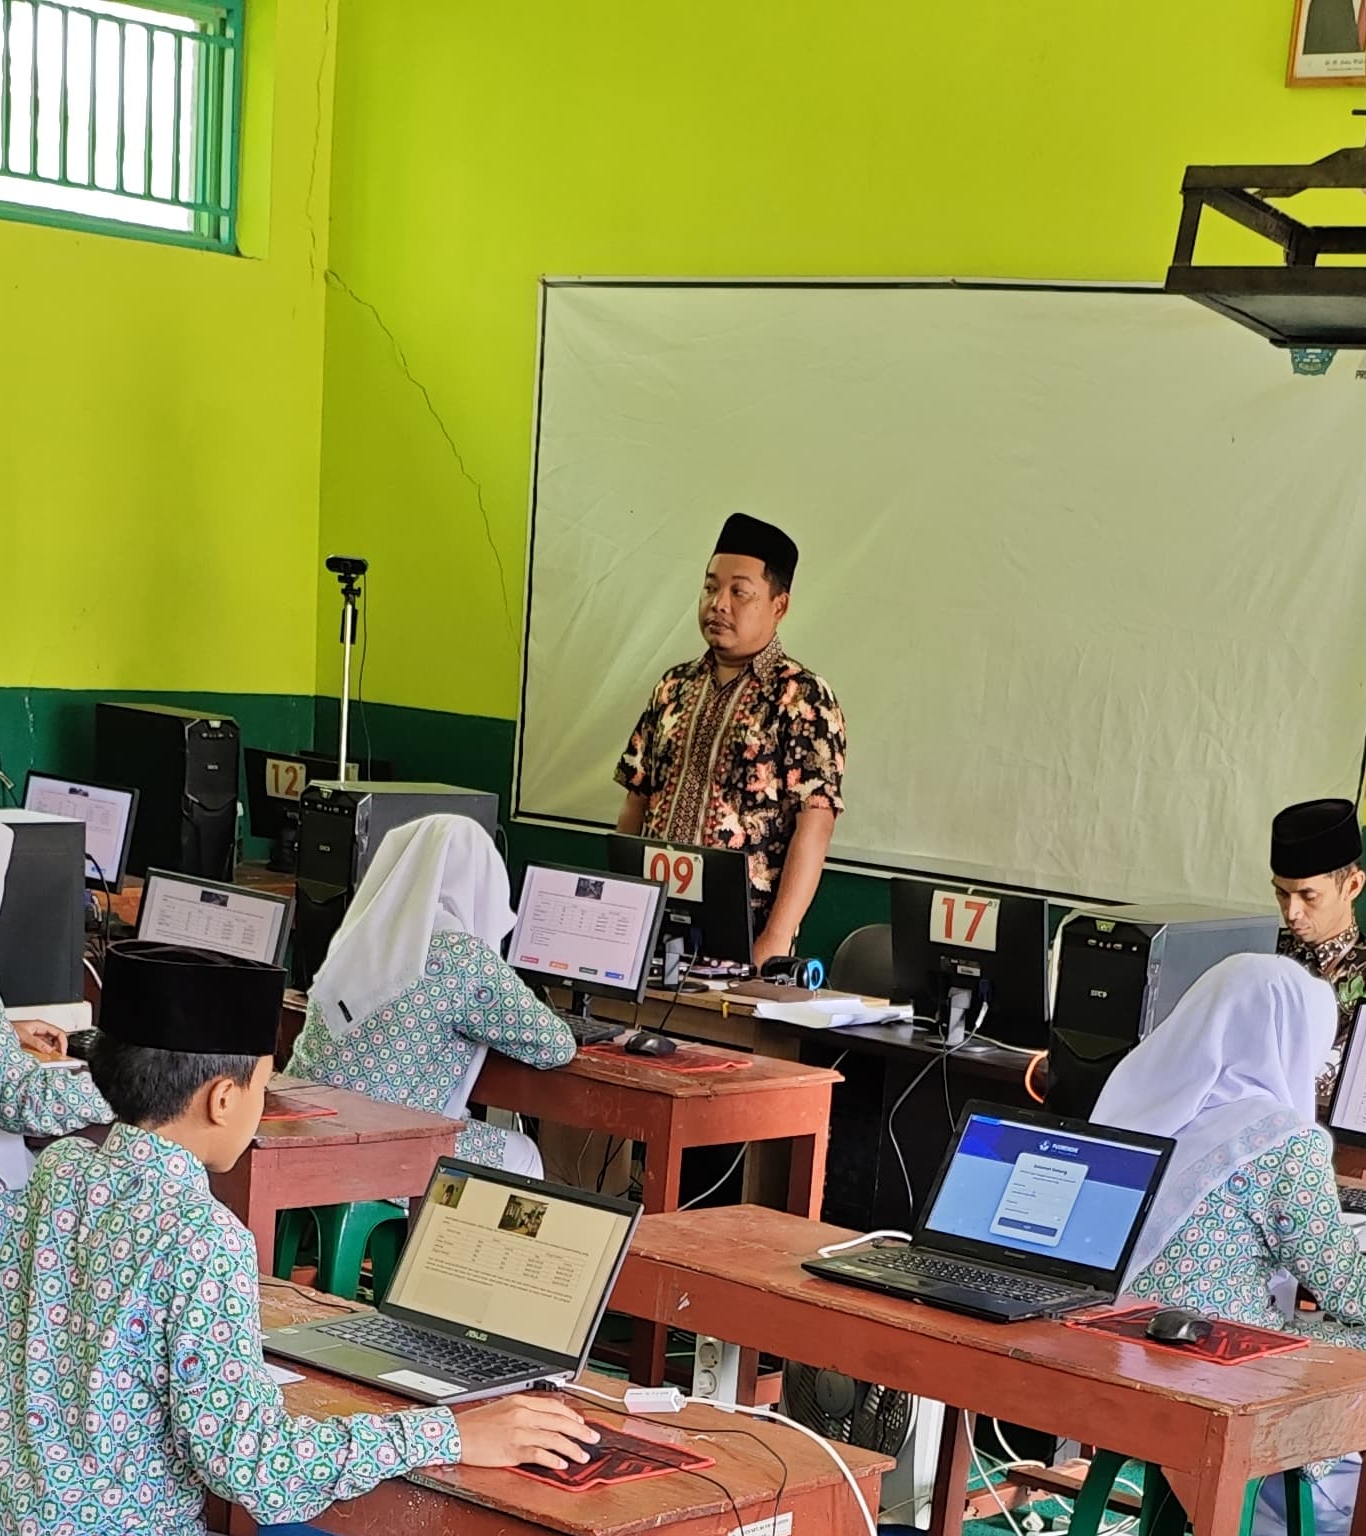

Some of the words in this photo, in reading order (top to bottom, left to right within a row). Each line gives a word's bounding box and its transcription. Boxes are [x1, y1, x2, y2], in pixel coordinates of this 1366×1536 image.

[272, 764, 299, 797] 12
[650, 852, 693, 895] 09
[942, 898, 988, 943] 17
